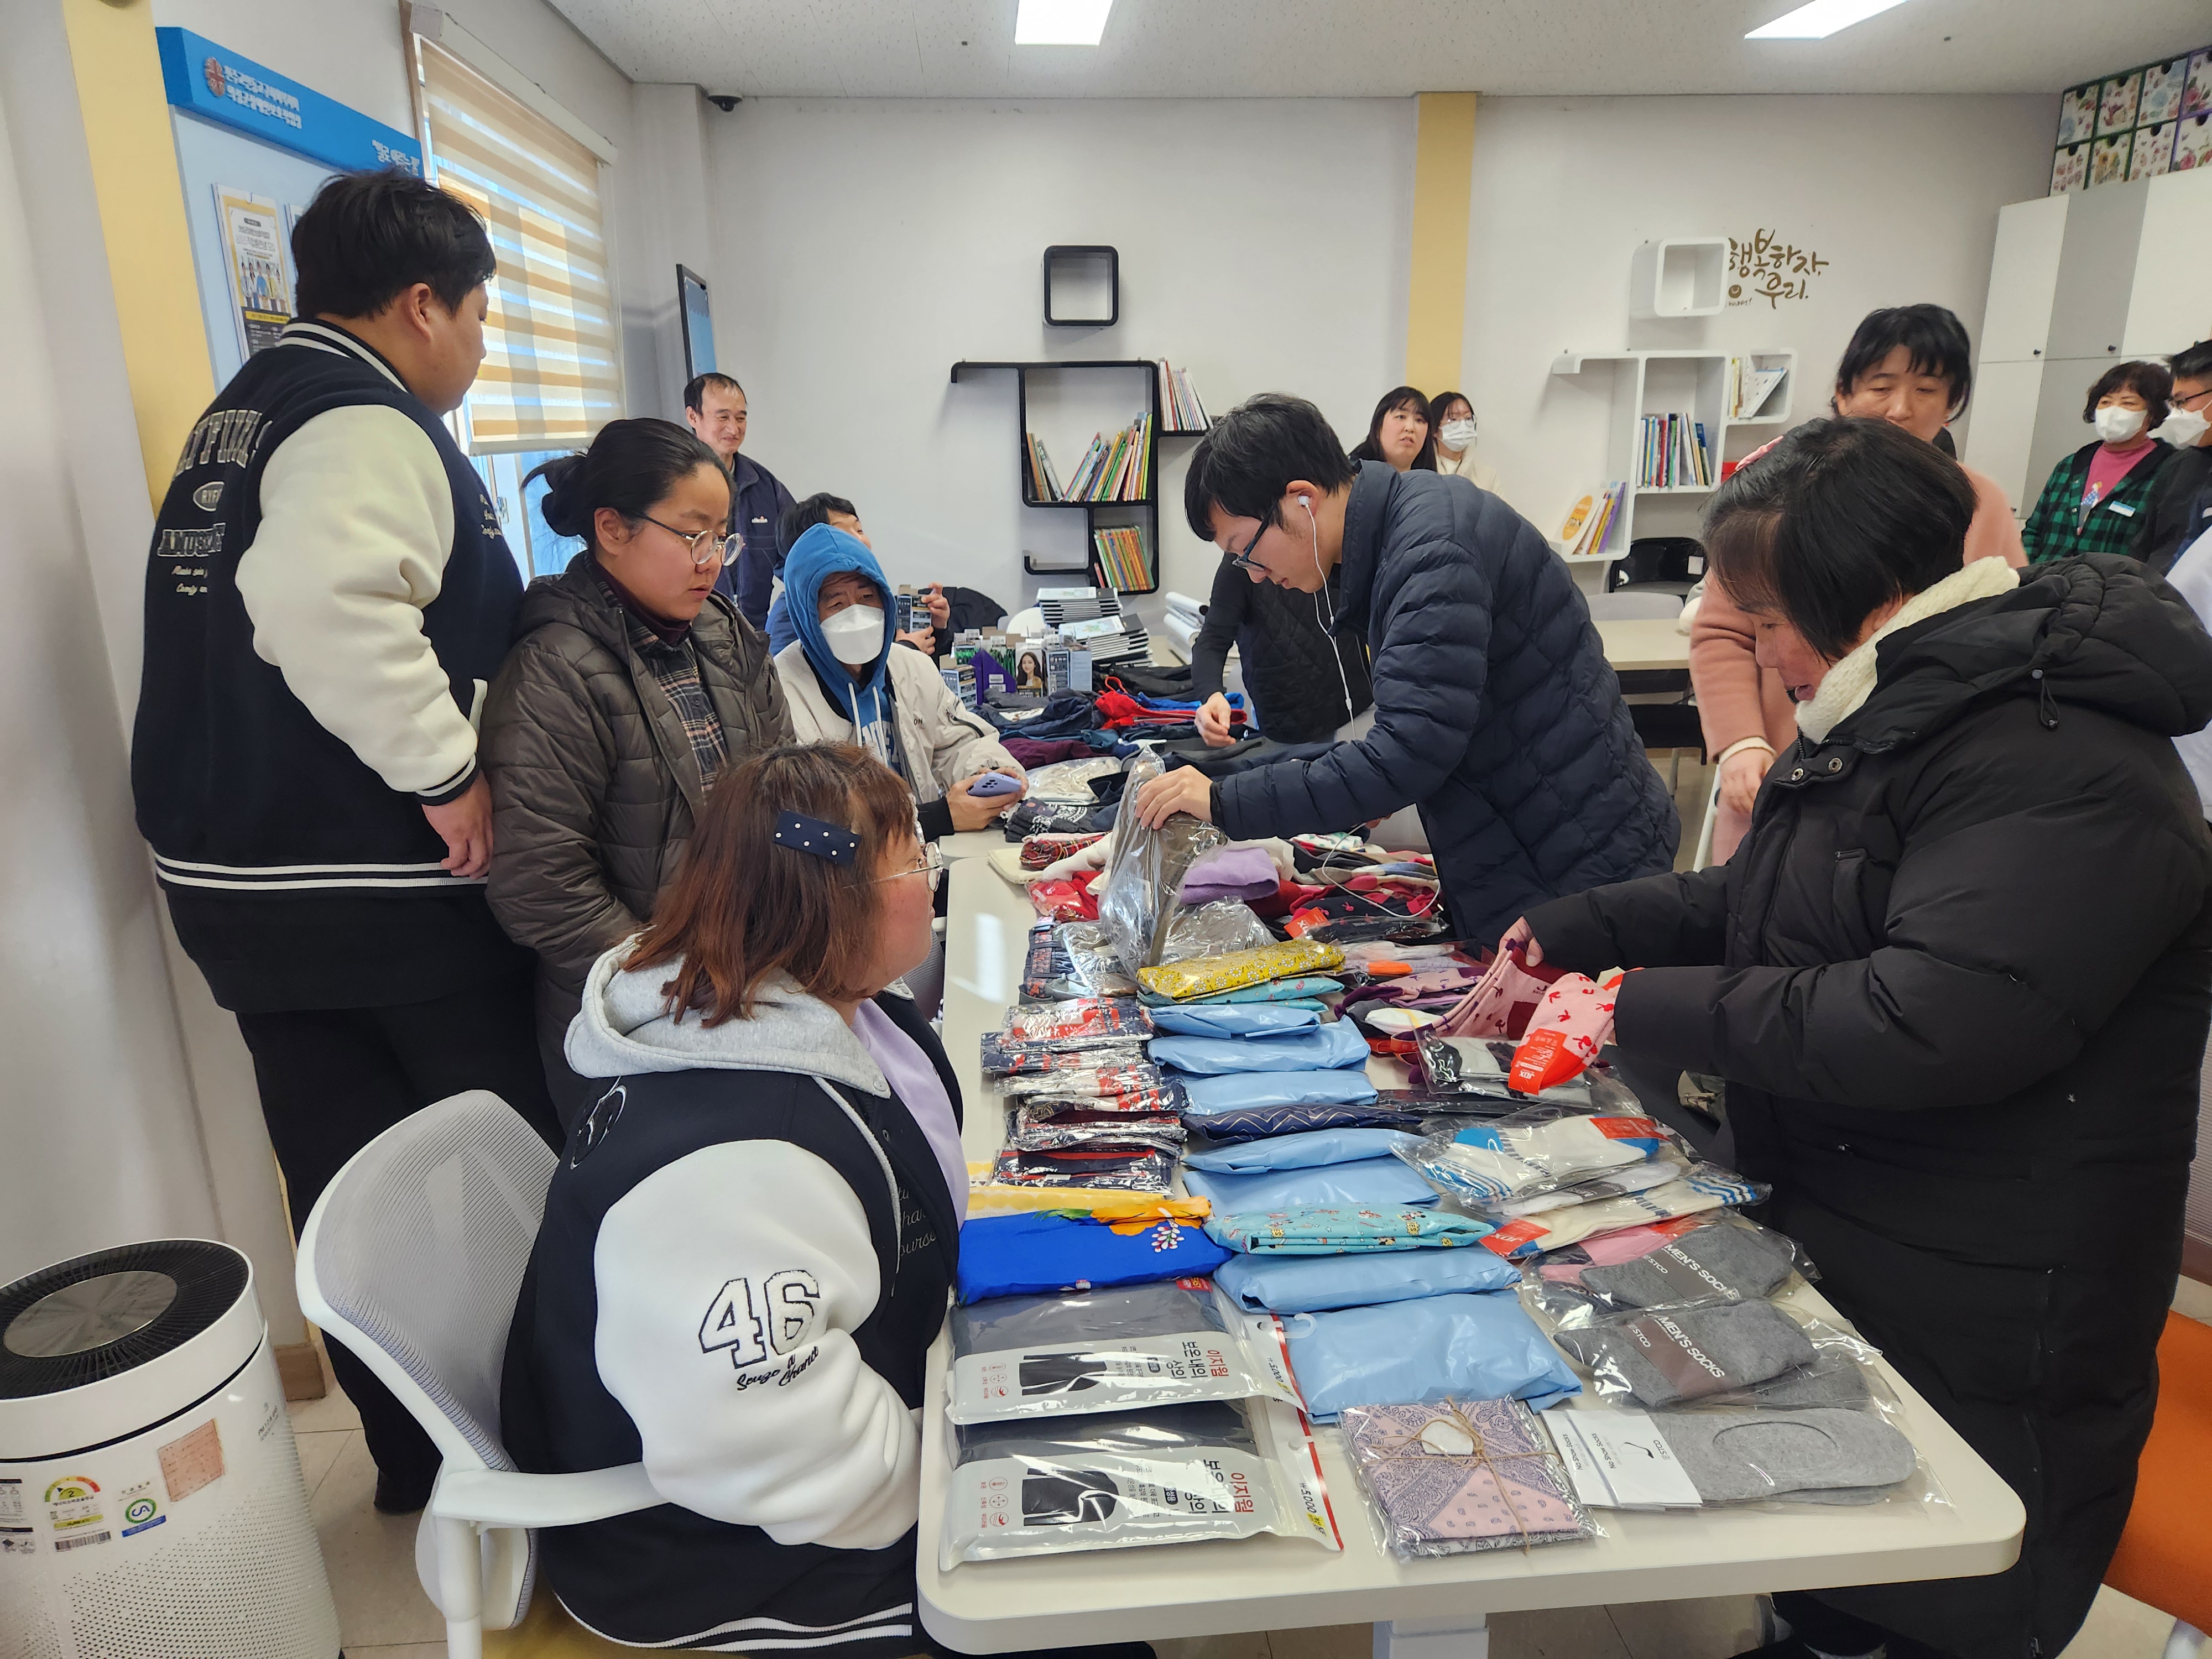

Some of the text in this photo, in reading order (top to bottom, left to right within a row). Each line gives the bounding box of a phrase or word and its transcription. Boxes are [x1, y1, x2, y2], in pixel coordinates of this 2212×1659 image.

[1519, 1070, 1535, 1080] JDX
[1494, 1233, 1523, 1242] JDX
[1664, 1244, 1701, 1271] MEN'S
[1647, 1258, 1668, 1274] STCO
[698, 1270, 821, 1369] 46
[1632, 1327, 1651, 1348] STCO
[1658, 1316, 1693, 1348] MEN'S
[1687, 1347, 1725, 1378] SOCKS
[1182, 1341, 1208, 1378] 보온 내의
[1206, 1349, 1229, 1377] 이지웜
[1166, 1360, 1187, 1379] 상의
[1562, 1433, 1573, 1448] Socks
[1592, 1433, 1603, 1447] Socks
[1653, 1439, 1667, 1455] STCO
[1568, 1448, 1580, 1462] Show
[1600, 1447, 1611, 1461] Show
[1575, 1460, 1583, 1470] No
[1608, 1460, 1617, 1469] No
[980, 1481, 987, 1489] 보온
[1229, 1473, 1254, 1512] 이지웜
[1299, 1482, 1317, 1514] ₩5,000
